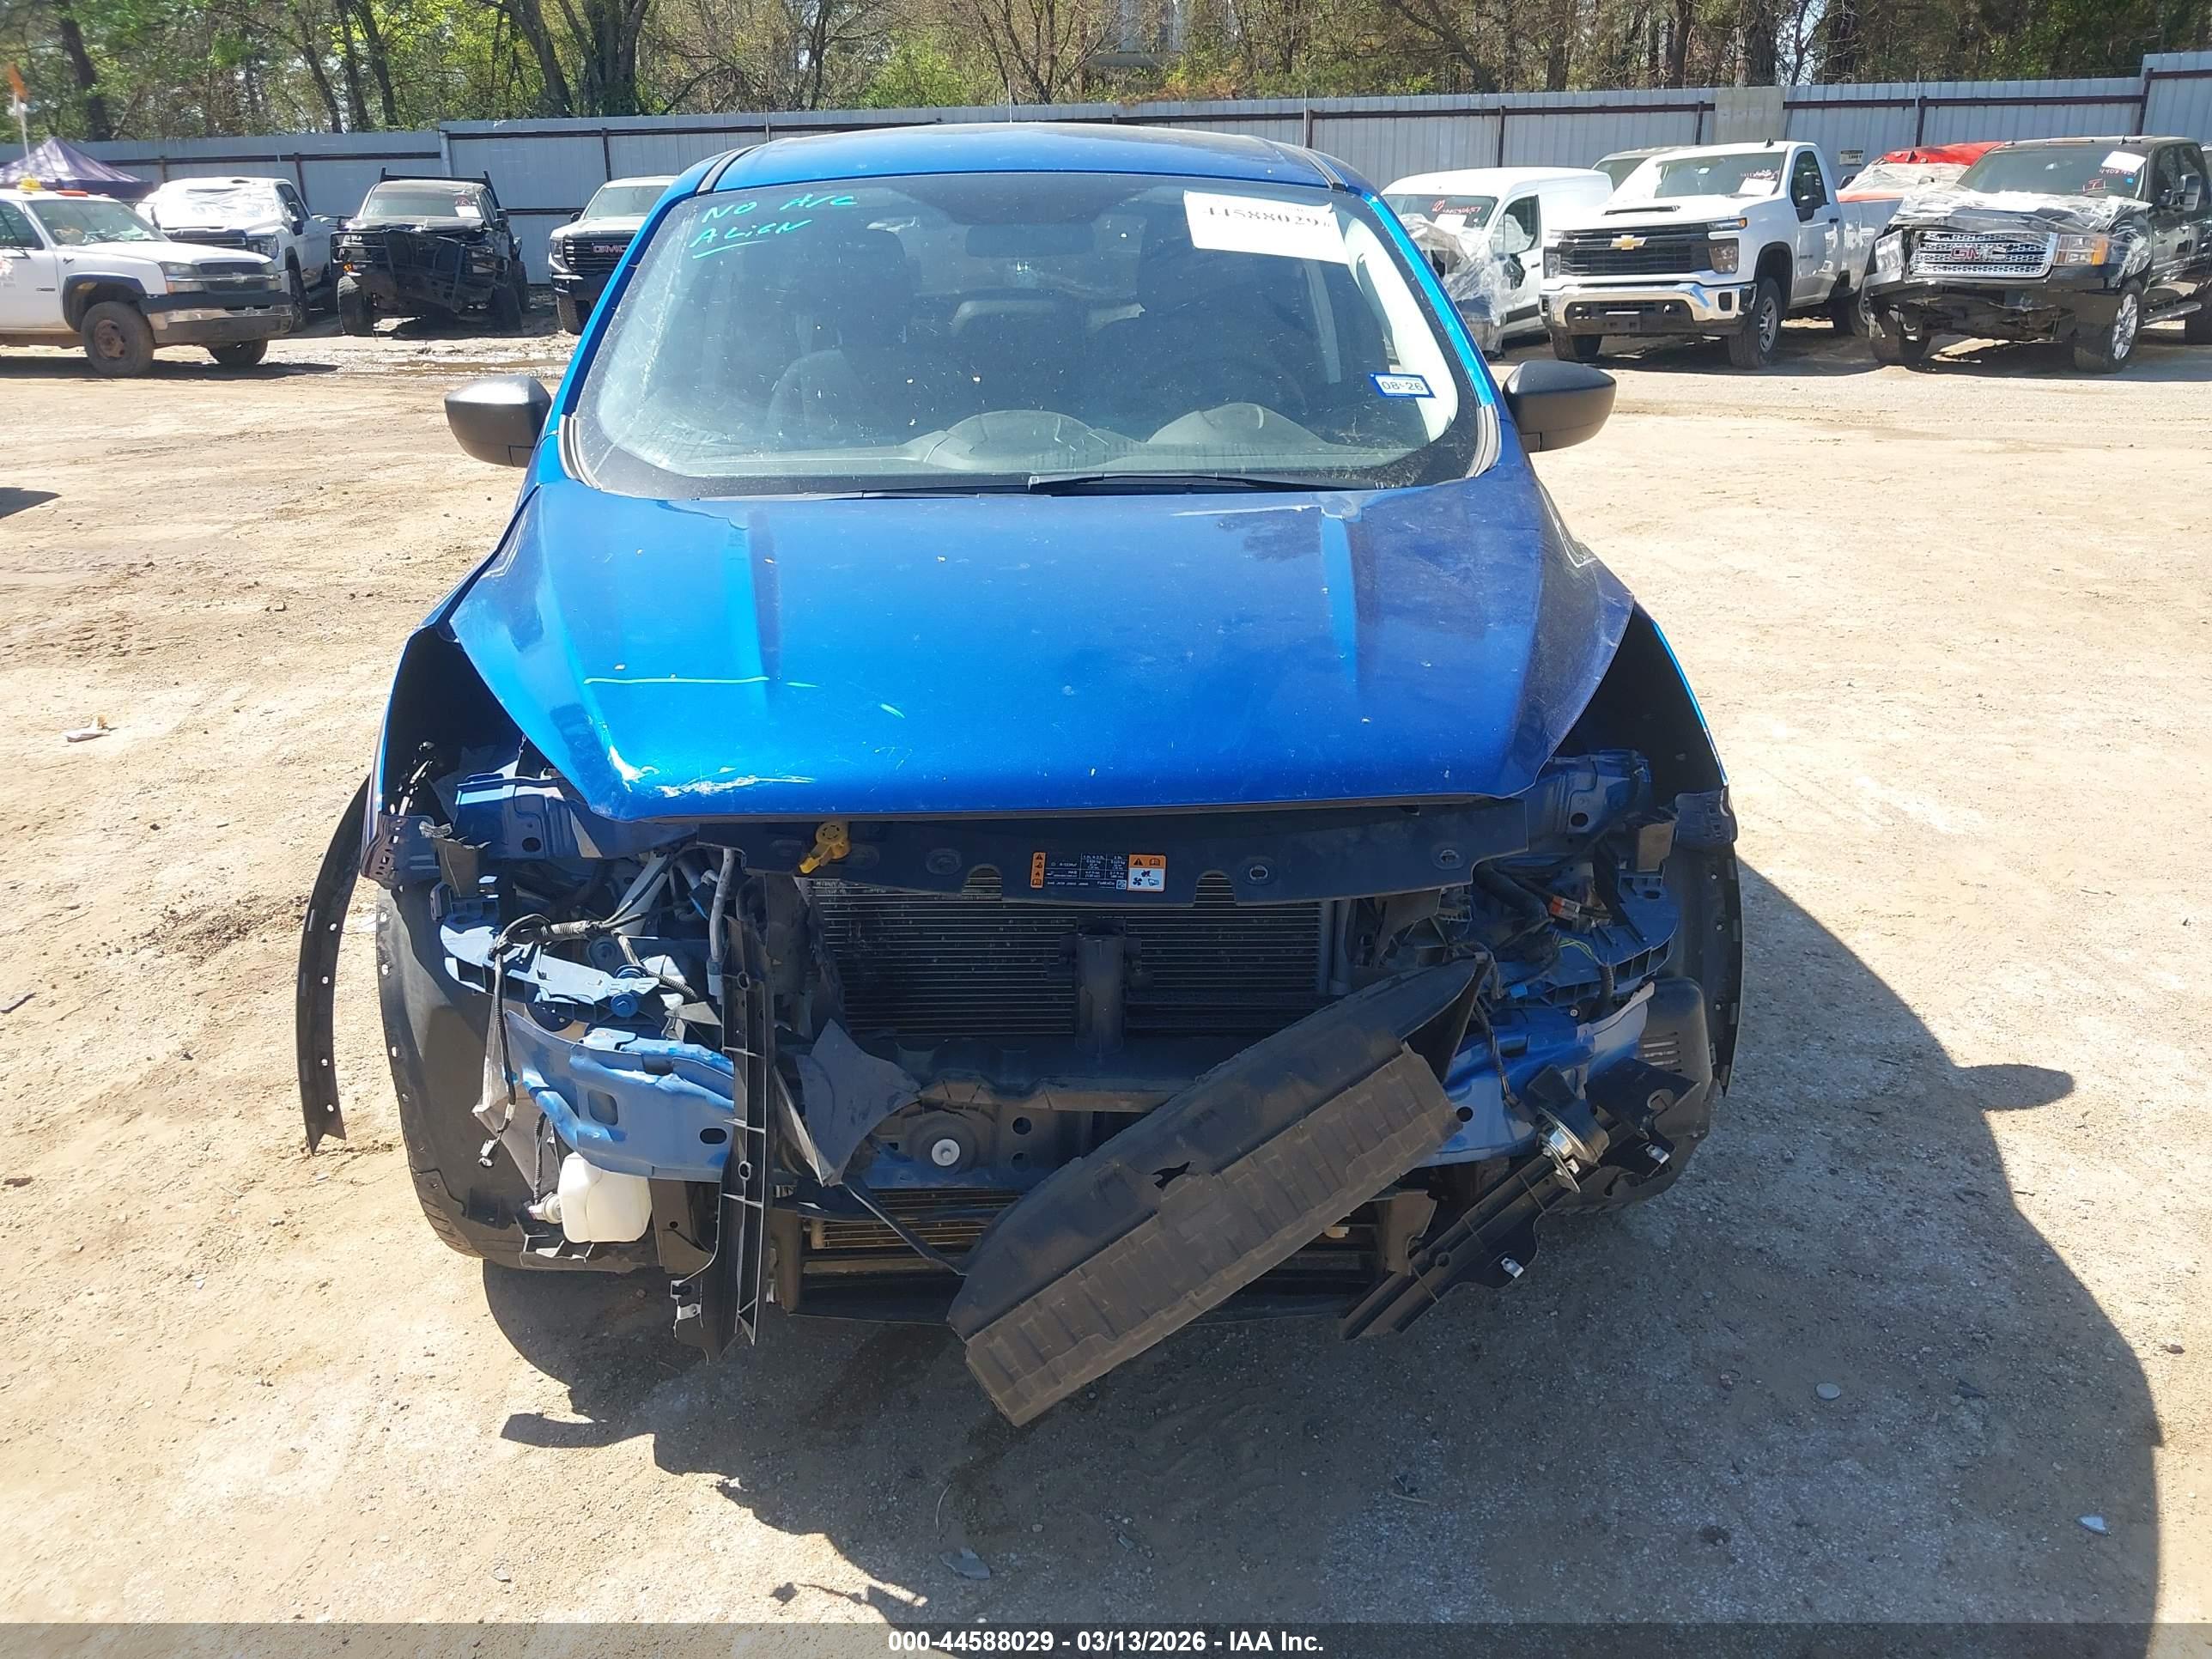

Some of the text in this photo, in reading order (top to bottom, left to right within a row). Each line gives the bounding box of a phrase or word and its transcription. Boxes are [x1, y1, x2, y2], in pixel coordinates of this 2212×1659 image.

[702, 193, 858, 223] NO A/C
[592, 245, 629, 253] GMC
[1951, 246, 2007, 260] GMC
